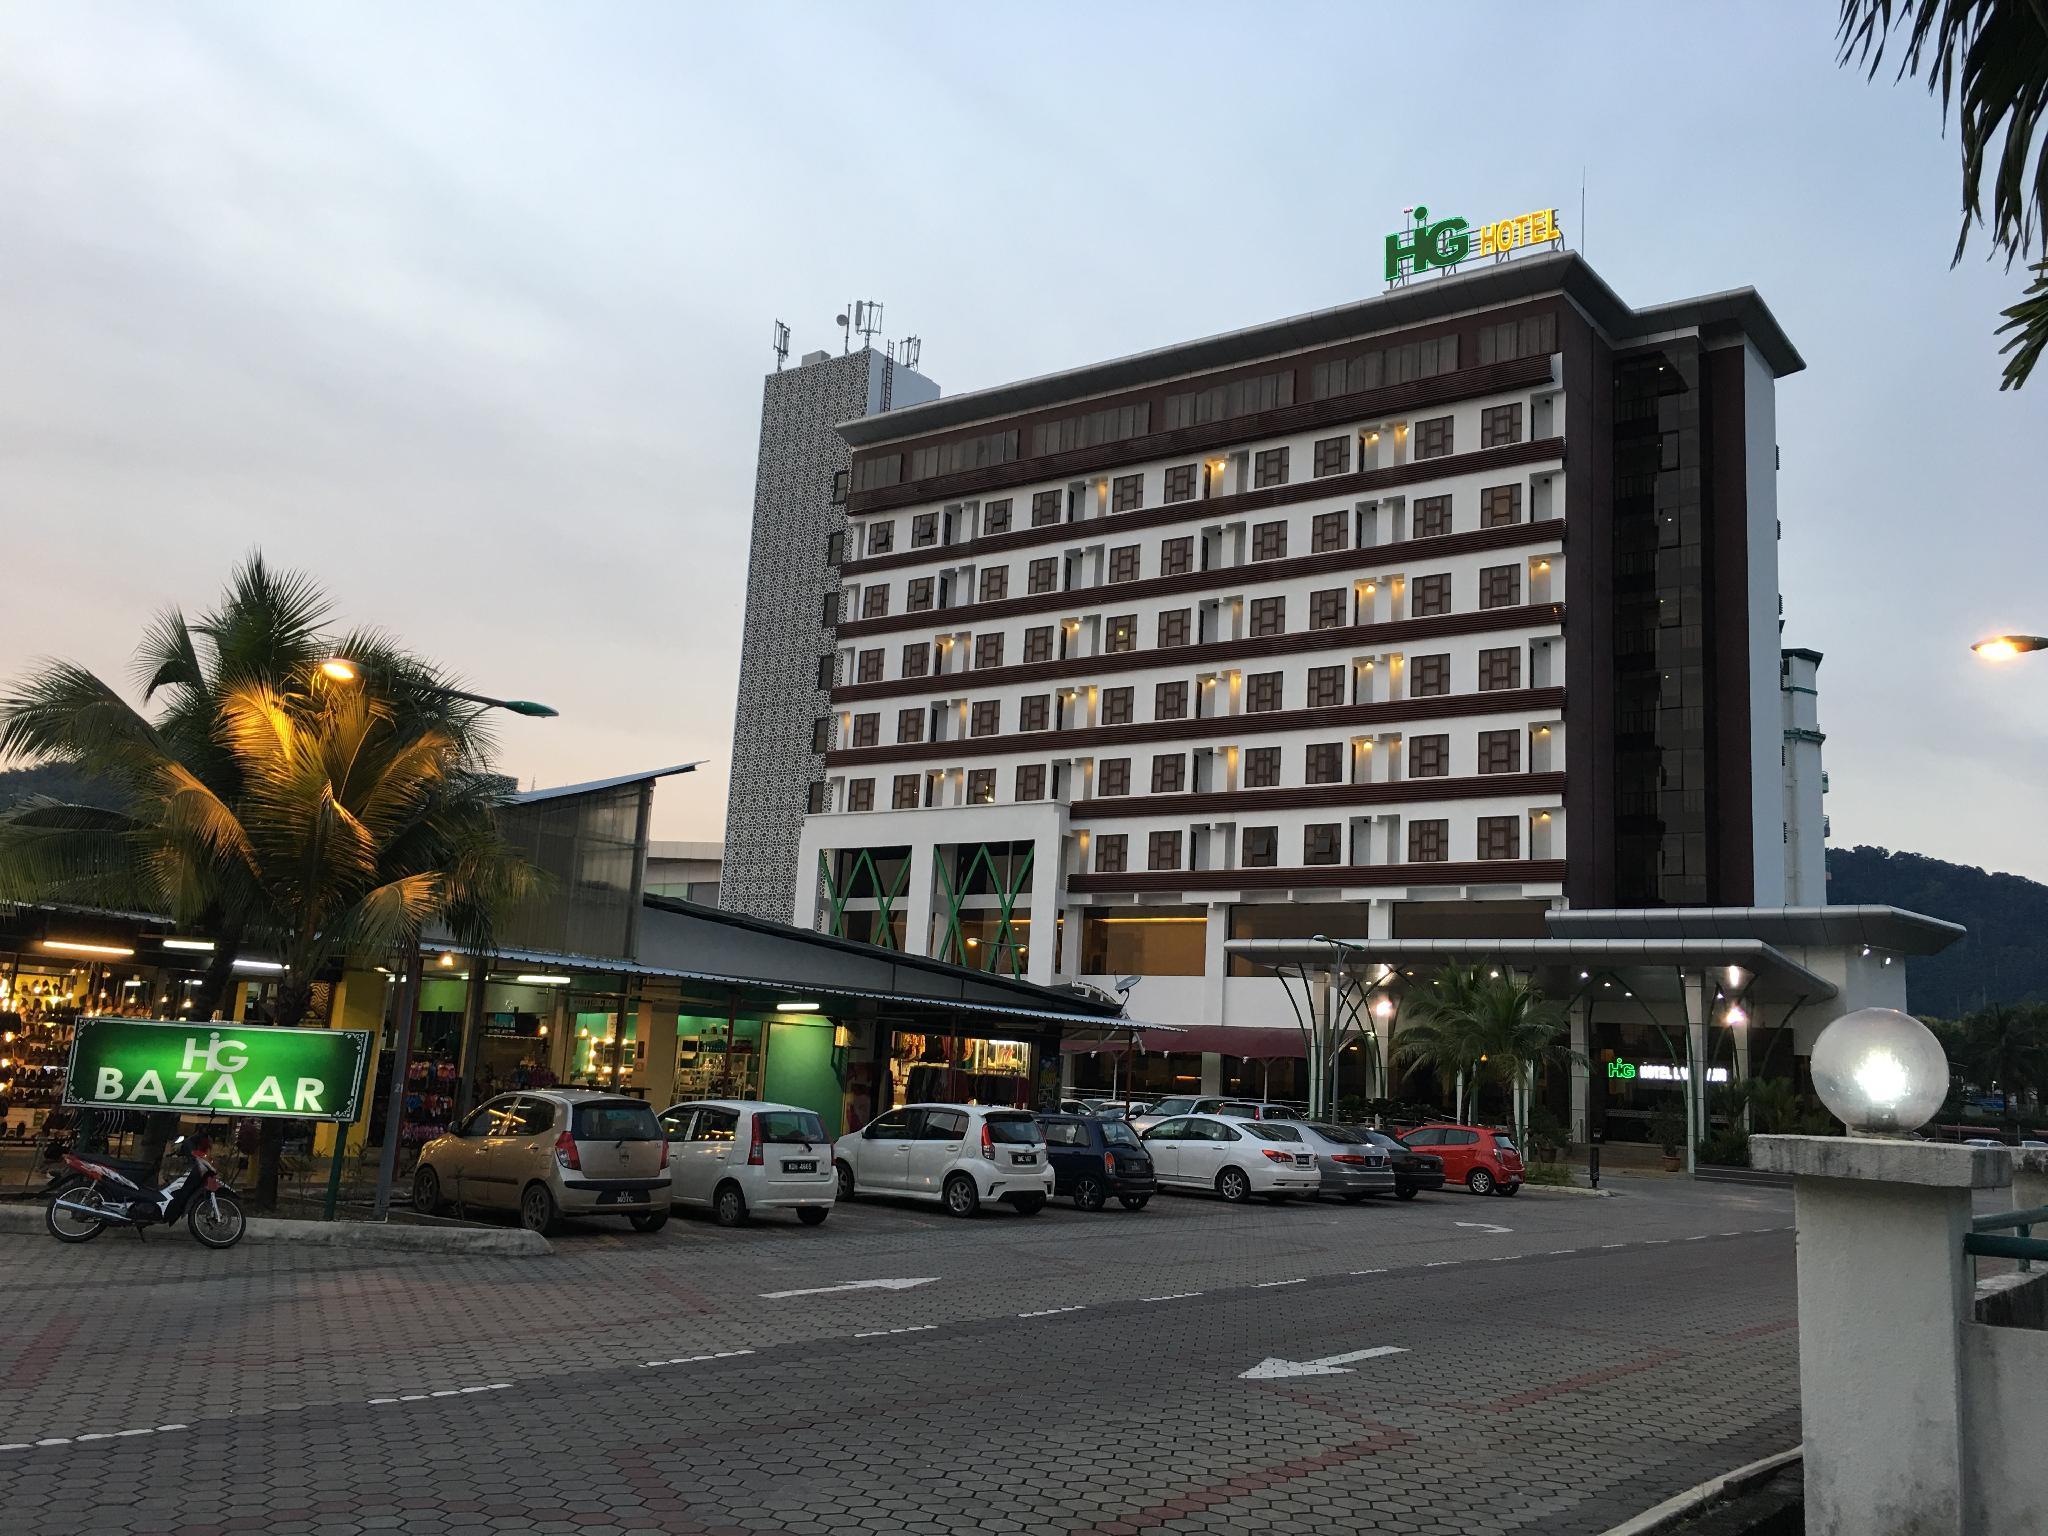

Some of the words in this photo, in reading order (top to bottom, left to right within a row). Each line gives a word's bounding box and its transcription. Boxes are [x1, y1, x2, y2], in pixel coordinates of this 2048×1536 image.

[1480, 208, 1560, 256] HOTEL
[94, 1067, 325, 1112] BAZAAR
[1640, 1066, 1672, 1080] HOTEL
